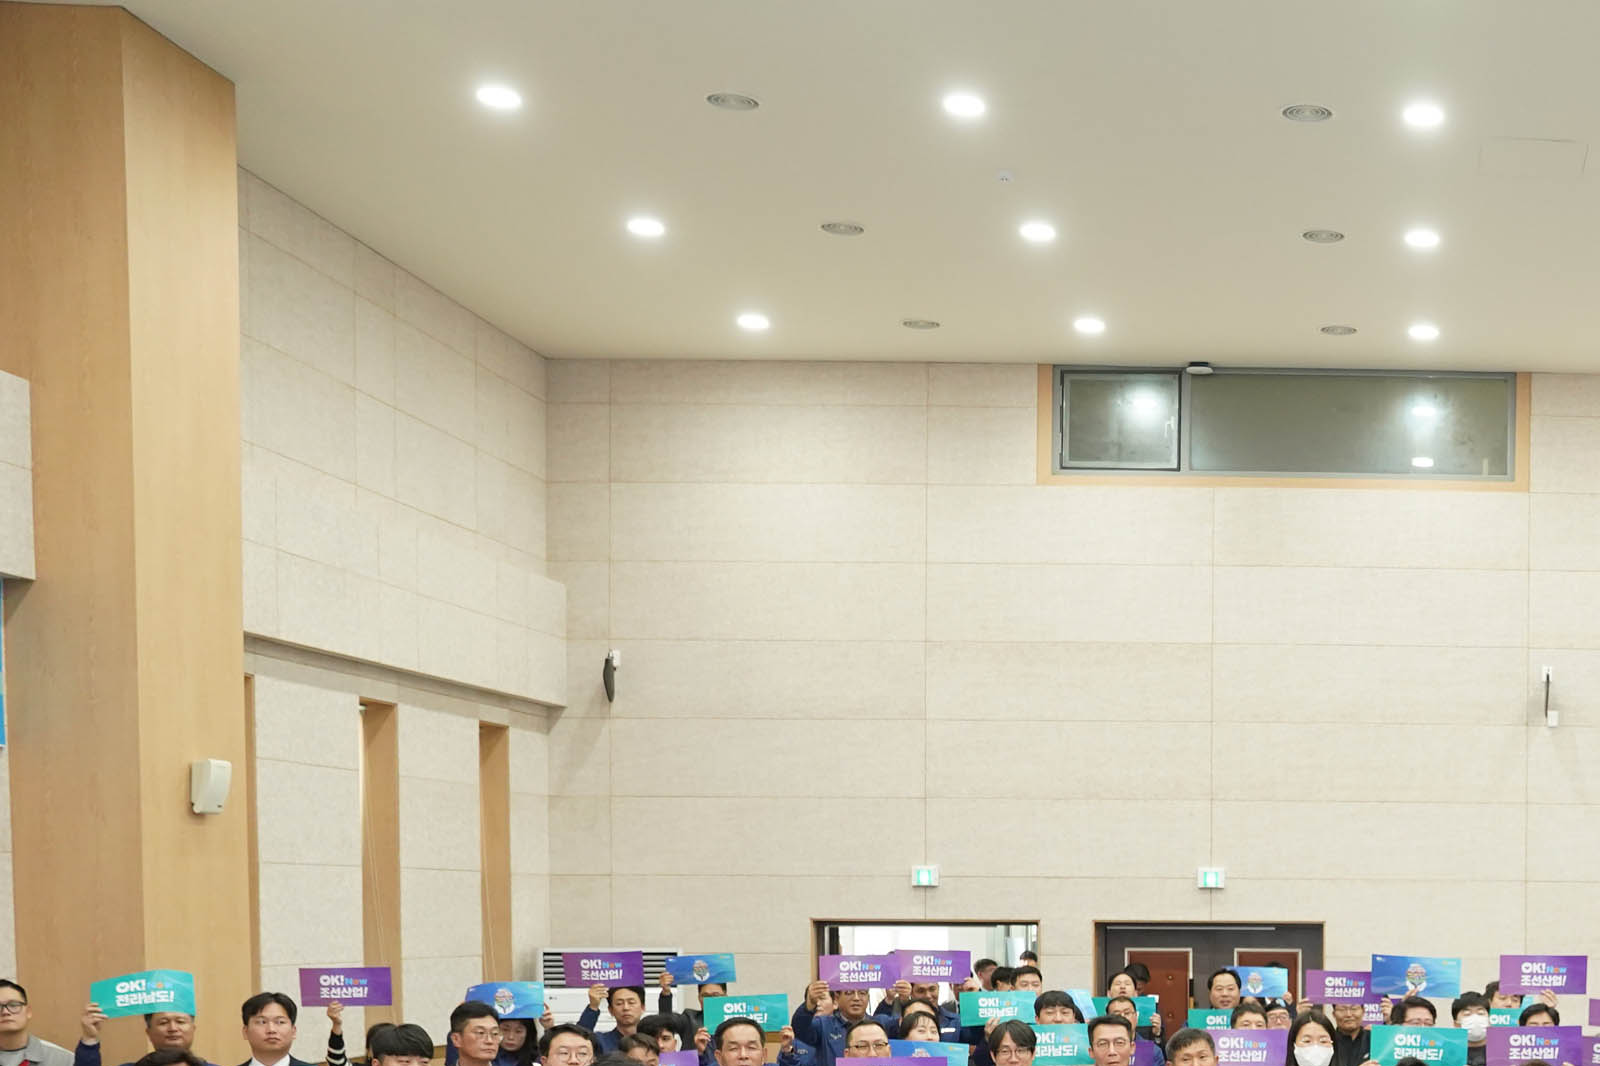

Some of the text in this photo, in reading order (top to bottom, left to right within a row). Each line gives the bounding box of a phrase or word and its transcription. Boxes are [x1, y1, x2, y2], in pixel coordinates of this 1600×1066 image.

[580, 958, 622, 970] OK! Now
[839, 961, 881, 972] OK! Now
[912, 955, 952, 966] OK! Now
[912, 965, 953, 977] 조선산업!
[1521, 962, 1567, 975] OK! Now
[319, 975, 367, 986] OK! Now
[581, 969, 623, 981] 조선산업!
[839, 971, 882, 983] 조선산업!
[1520, 974, 1566, 987] 조선산업!
[116, 979, 146, 994] OK!
[1324, 976, 1365, 987] OK! Now
[319, 986, 368, 999] 조선산업!
[1324, 987, 1365, 998] 조선산업!
[115, 990, 174, 1008] 전라남도!
[978, 997, 1000, 1007] OK!
[723, 1002, 747, 1014] OK!
[978, 1007, 1018, 1018] 전라남도!
[1206, 1015, 1227, 1025] OK!
[1489, 1014, 1510, 1025] OK!
[1218, 1037, 1268, 1049] OK! Now
[1394, 1034, 1420, 1047] OK!
[1509, 1034, 1559, 1047] OK! Now
[1218, 1050, 1267, 1063] 조선산업!
[1508, 1047, 1559, 1060] 조선산업!
